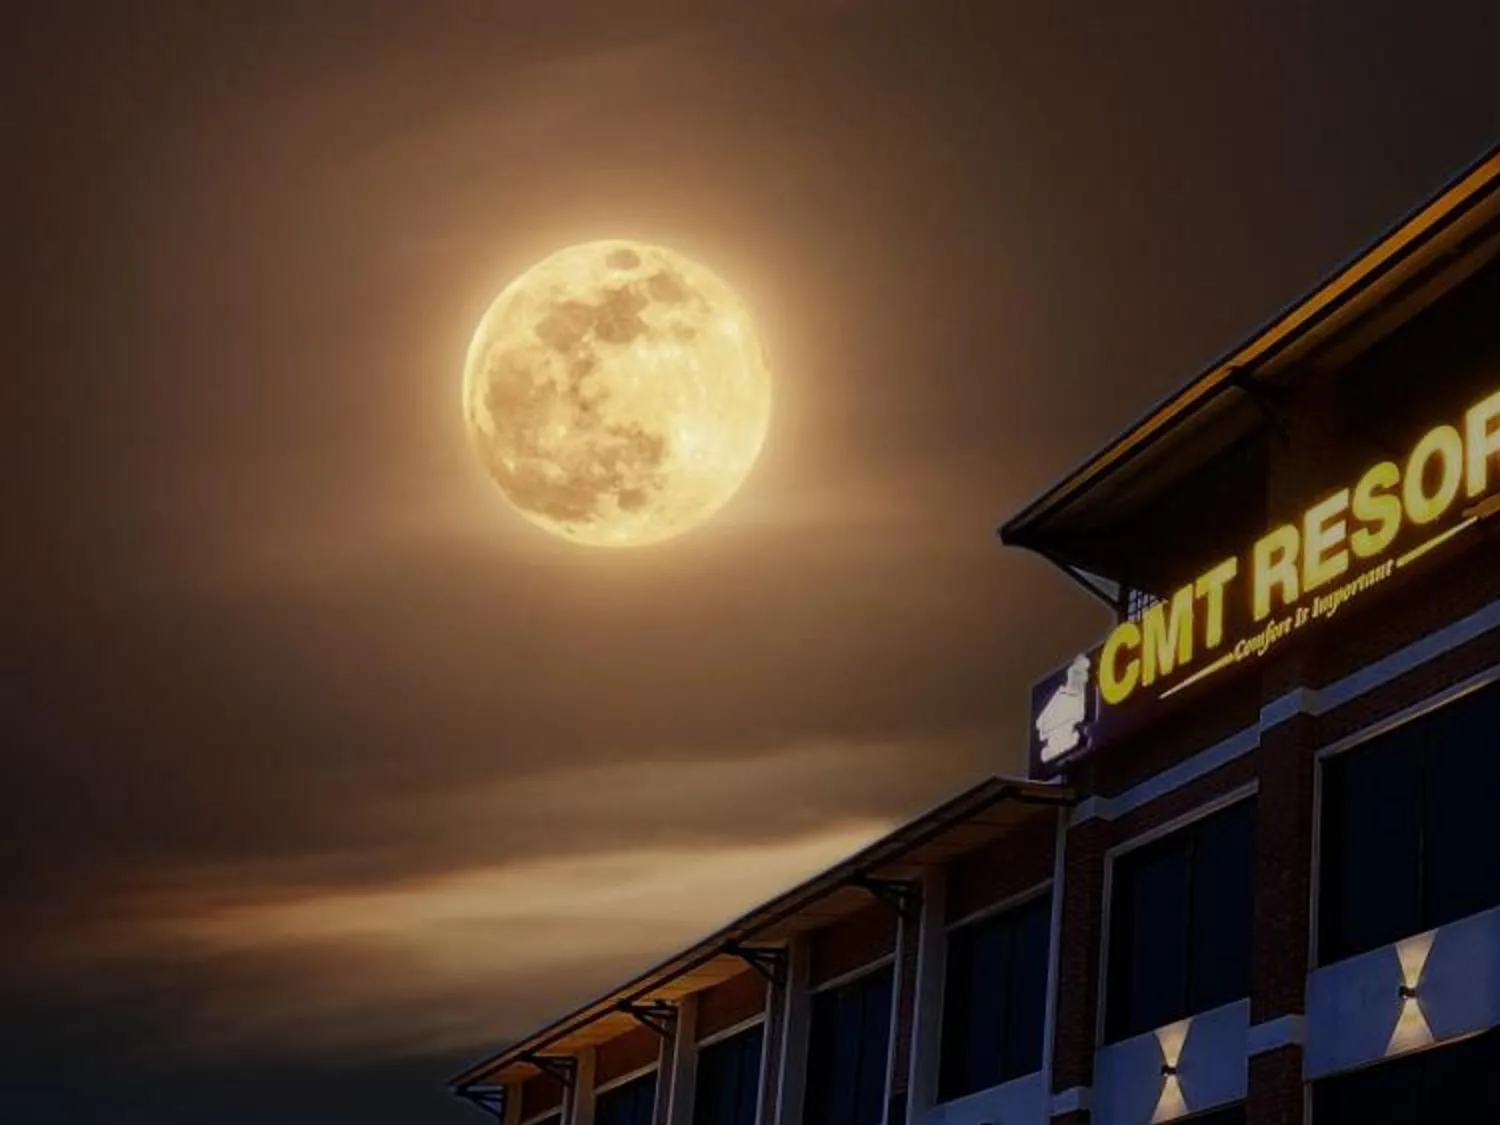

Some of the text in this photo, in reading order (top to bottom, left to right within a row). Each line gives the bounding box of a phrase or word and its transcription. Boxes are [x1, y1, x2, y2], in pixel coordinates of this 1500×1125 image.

[1098, 556, 1238, 706] CMT
[1233, 618, 1293, 662] Comfort
[1311, 558, 1395, 619] Important
